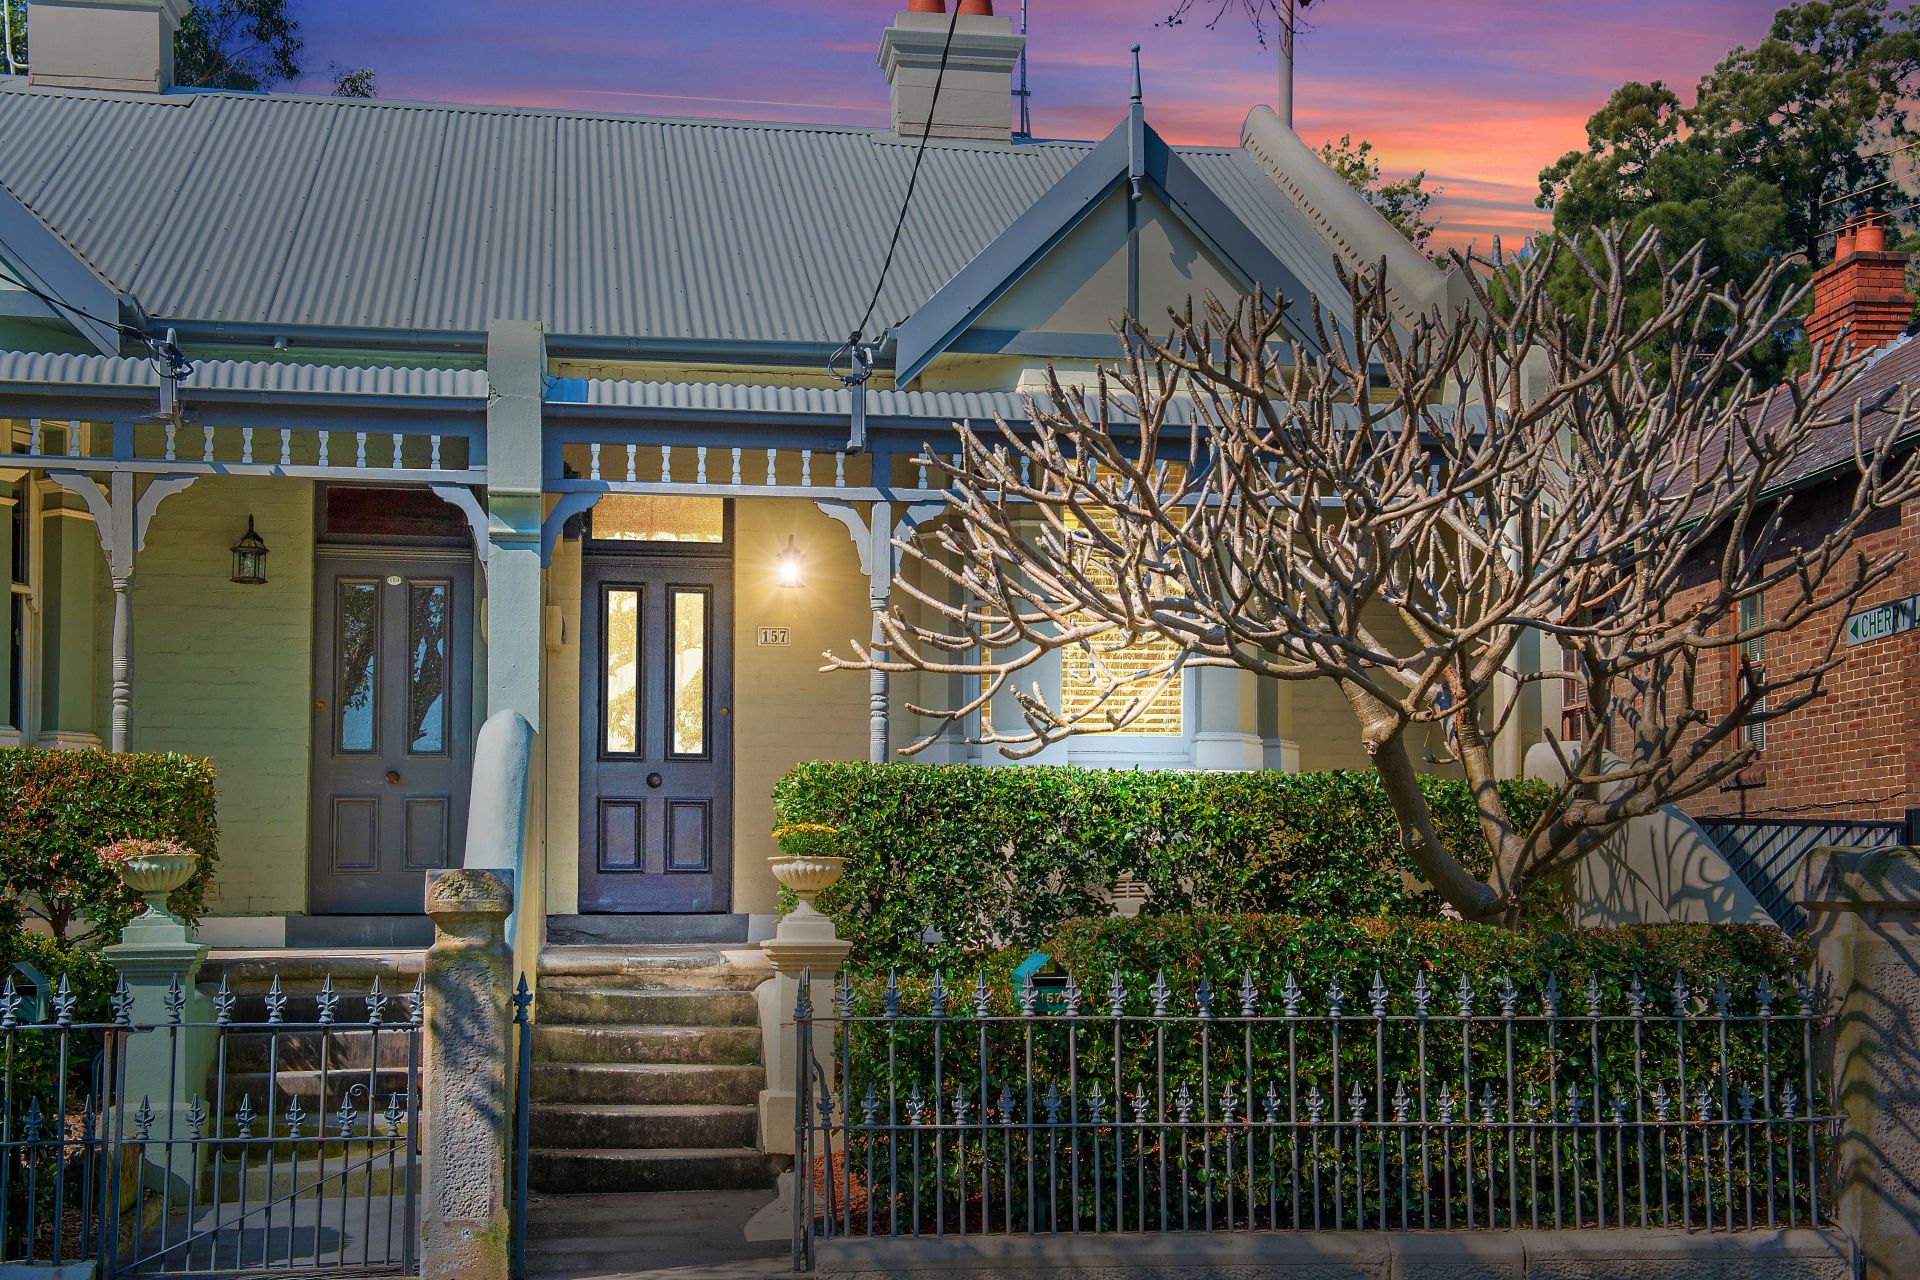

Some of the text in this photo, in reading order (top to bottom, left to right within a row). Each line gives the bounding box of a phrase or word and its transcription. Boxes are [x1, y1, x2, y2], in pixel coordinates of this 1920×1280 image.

[1861, 598, 1920, 639] CHERRY L
[763, 630, 787, 643] 157
[1040, 992, 1063, 1004] 157
